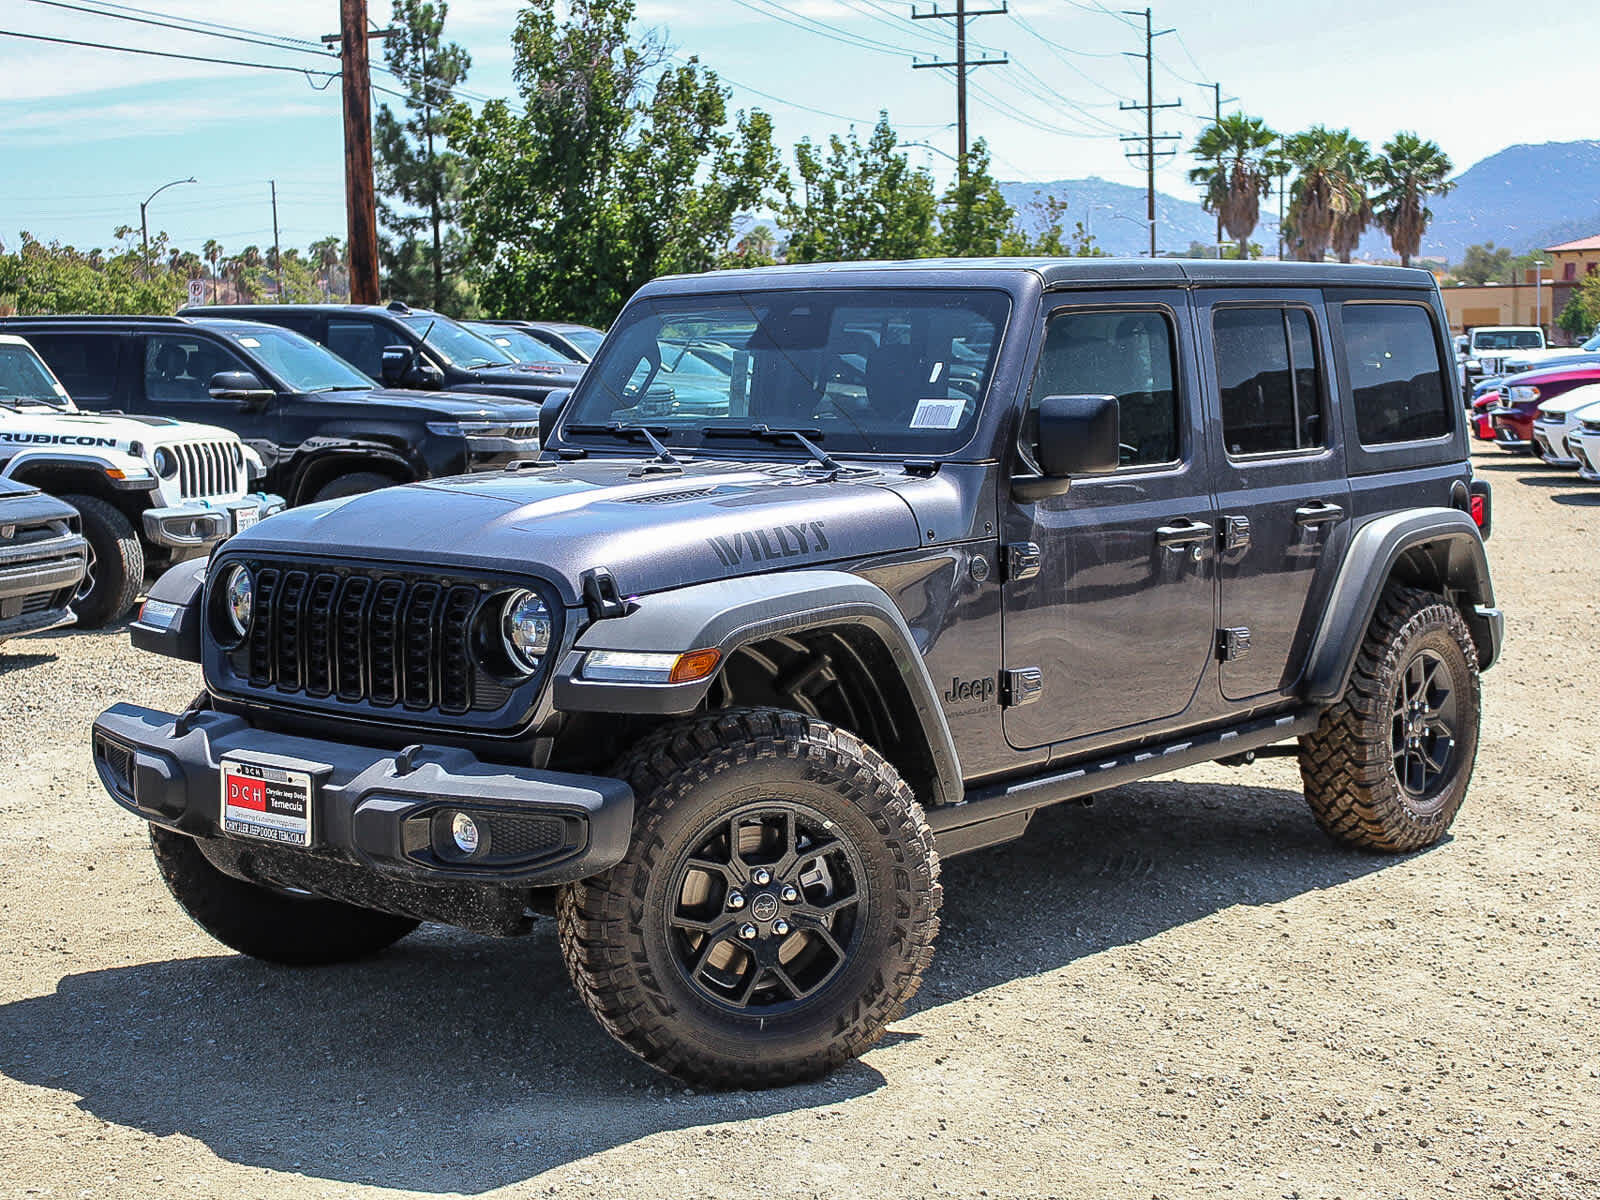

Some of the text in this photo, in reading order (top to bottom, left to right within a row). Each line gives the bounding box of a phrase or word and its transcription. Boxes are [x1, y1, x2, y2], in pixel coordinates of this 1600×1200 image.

[0, 432, 117, 447] RUBICON
[705, 520, 829, 566] WILLYS
[945, 677, 996, 704] Jeep
[231, 784, 262, 802] DCH
[270, 798, 303, 812] Temecula
